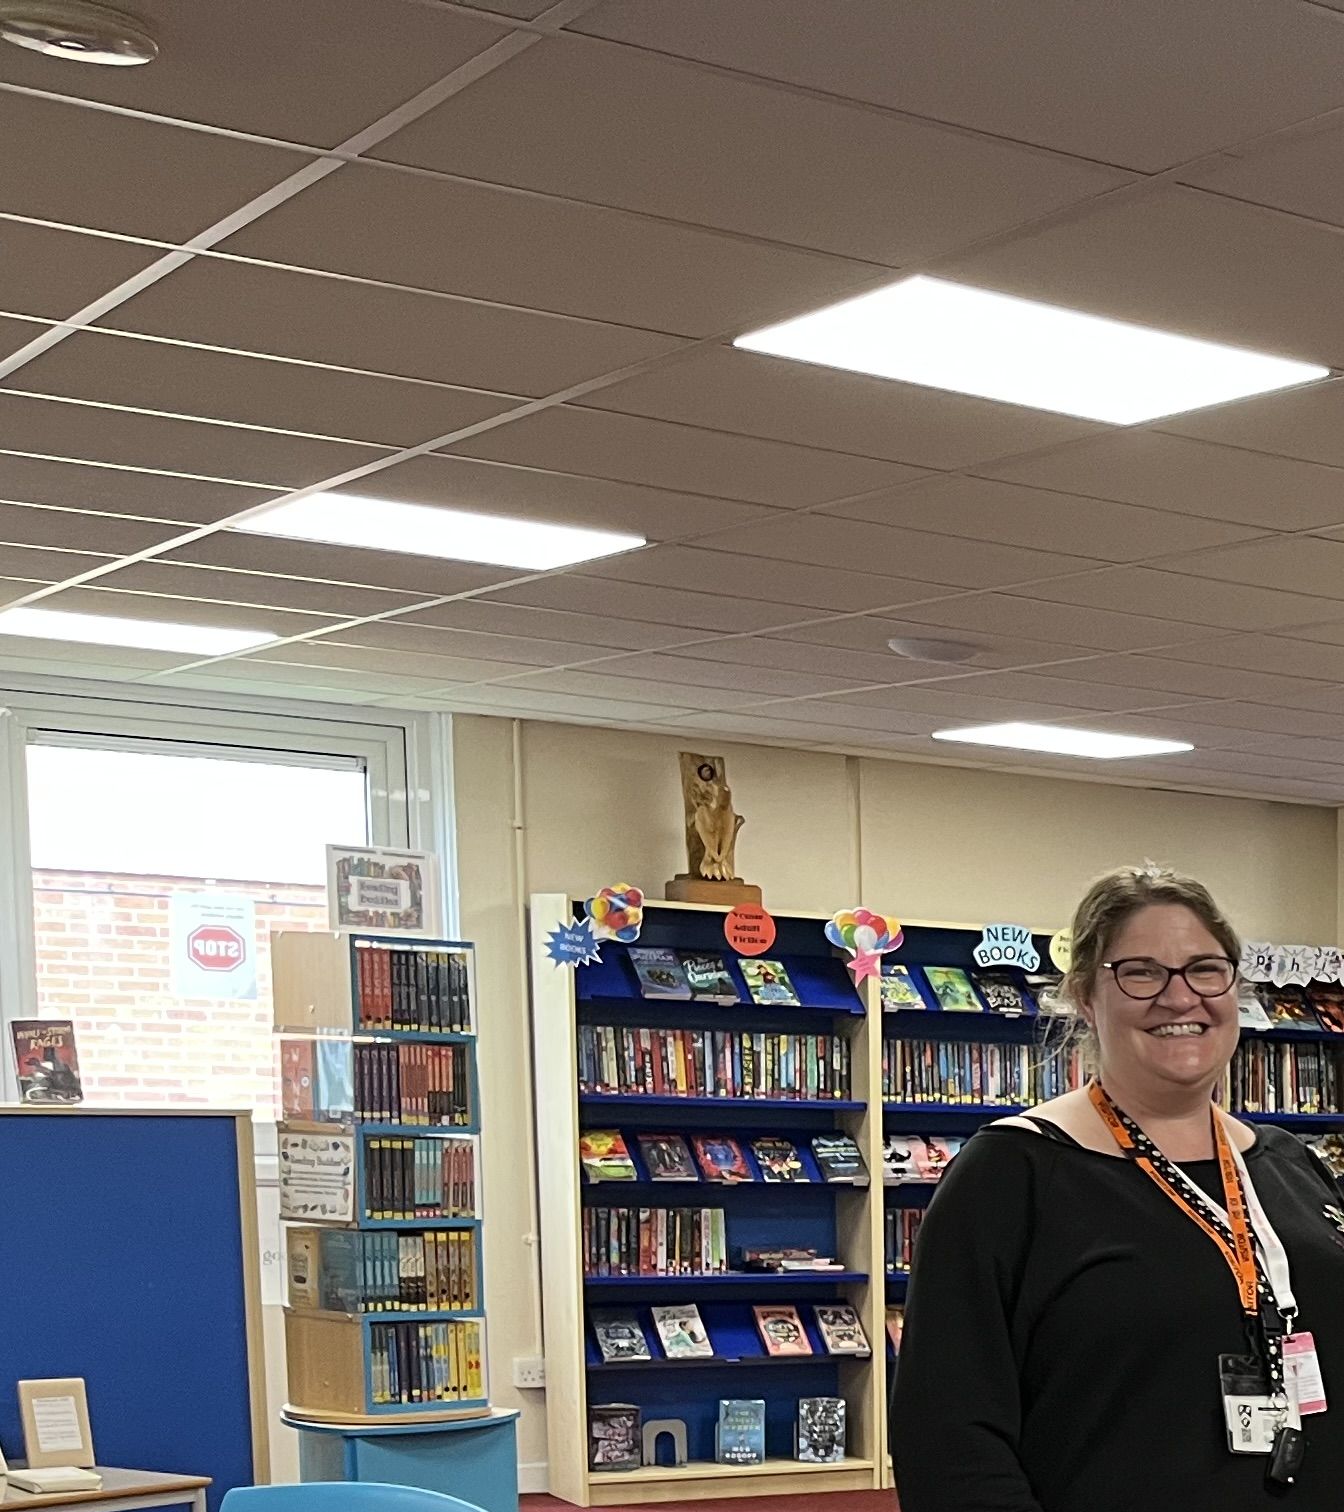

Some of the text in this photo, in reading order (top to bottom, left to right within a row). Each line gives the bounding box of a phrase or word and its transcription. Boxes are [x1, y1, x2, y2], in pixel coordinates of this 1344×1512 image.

[564, 933, 585, 943] NEW
[986, 926, 1031, 944] NEW
[978, 946, 1038, 970] BOOKS
